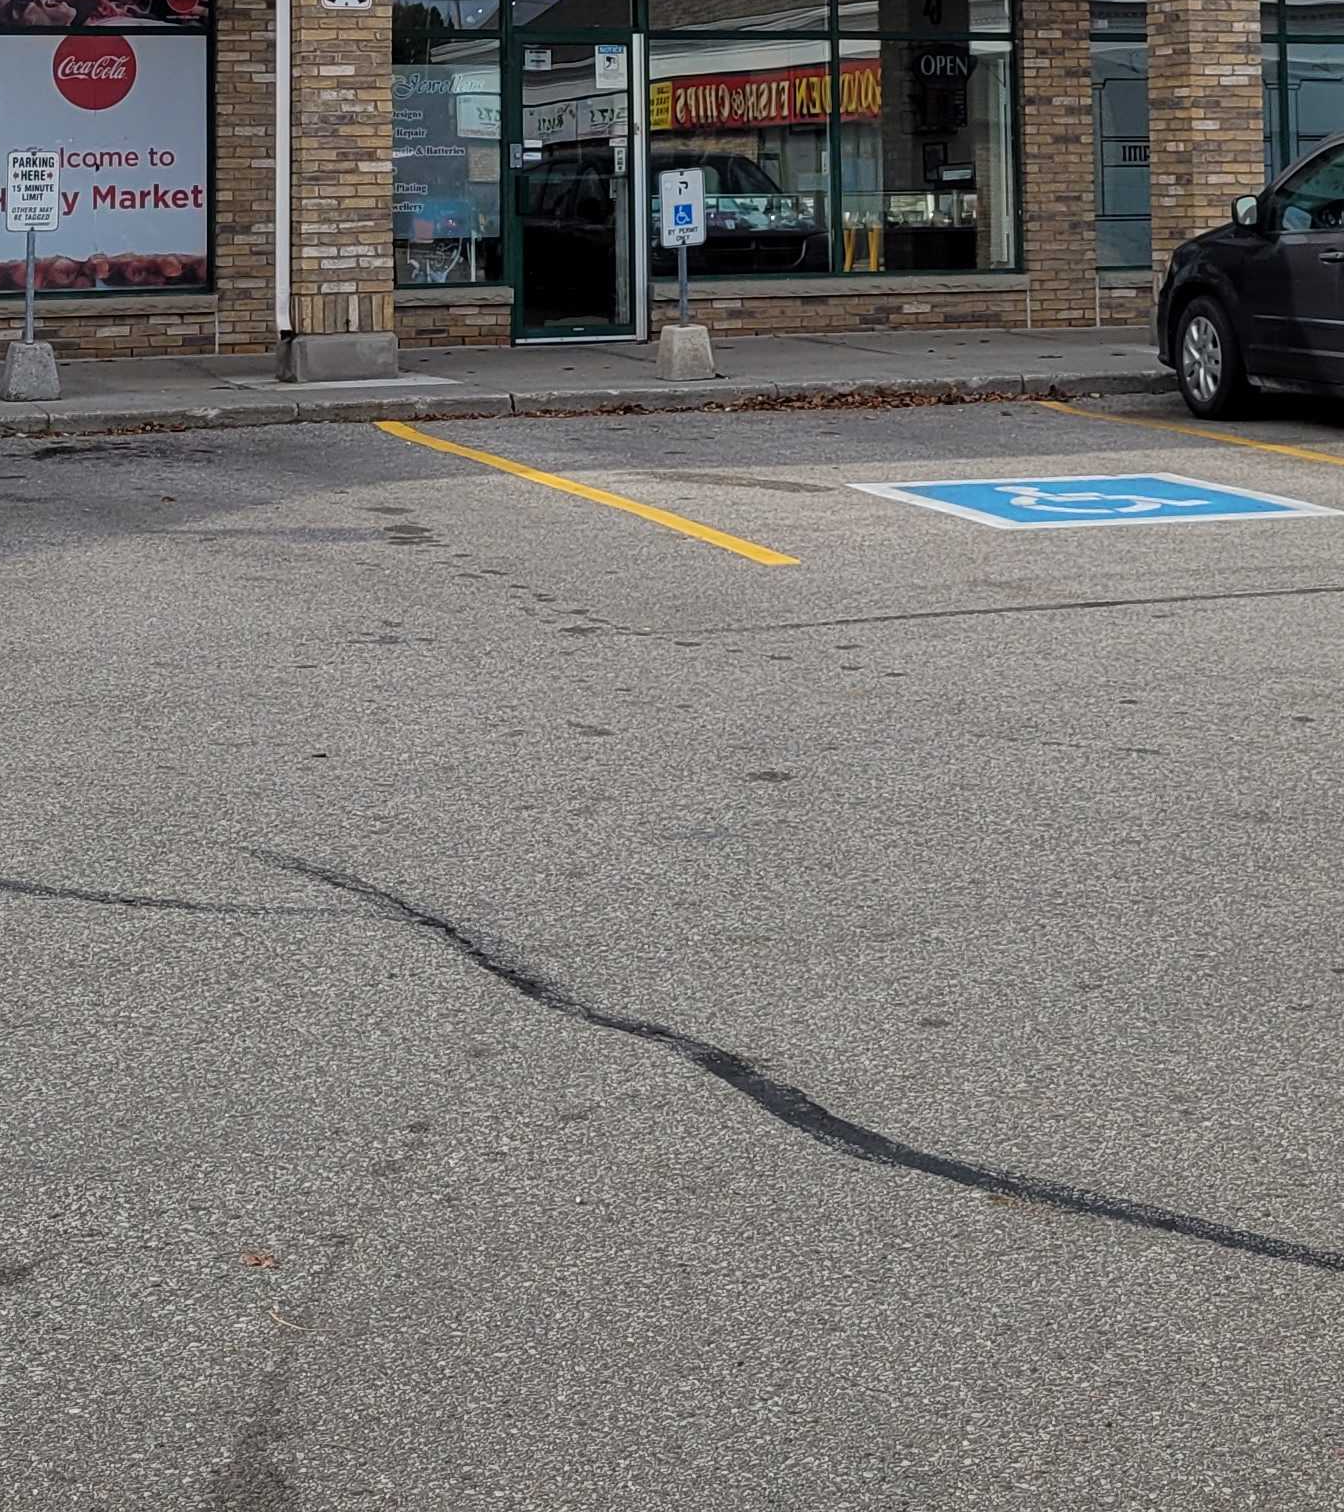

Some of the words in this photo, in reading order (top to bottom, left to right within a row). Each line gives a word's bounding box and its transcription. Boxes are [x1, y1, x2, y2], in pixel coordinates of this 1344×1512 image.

[57, 55, 130, 80] Coca-Cola
[920, 54, 969, 76] OPEN
[12, 157, 55, 169] PARKING
[58, 147, 139, 169] lcome
[148, 148, 175, 167] to
[20, 170, 46, 181] HERE
[24, 184, 54, 192] MINUTE
[22, 193, 43, 201] LIMIT
[92, 184, 204, 210] Market
